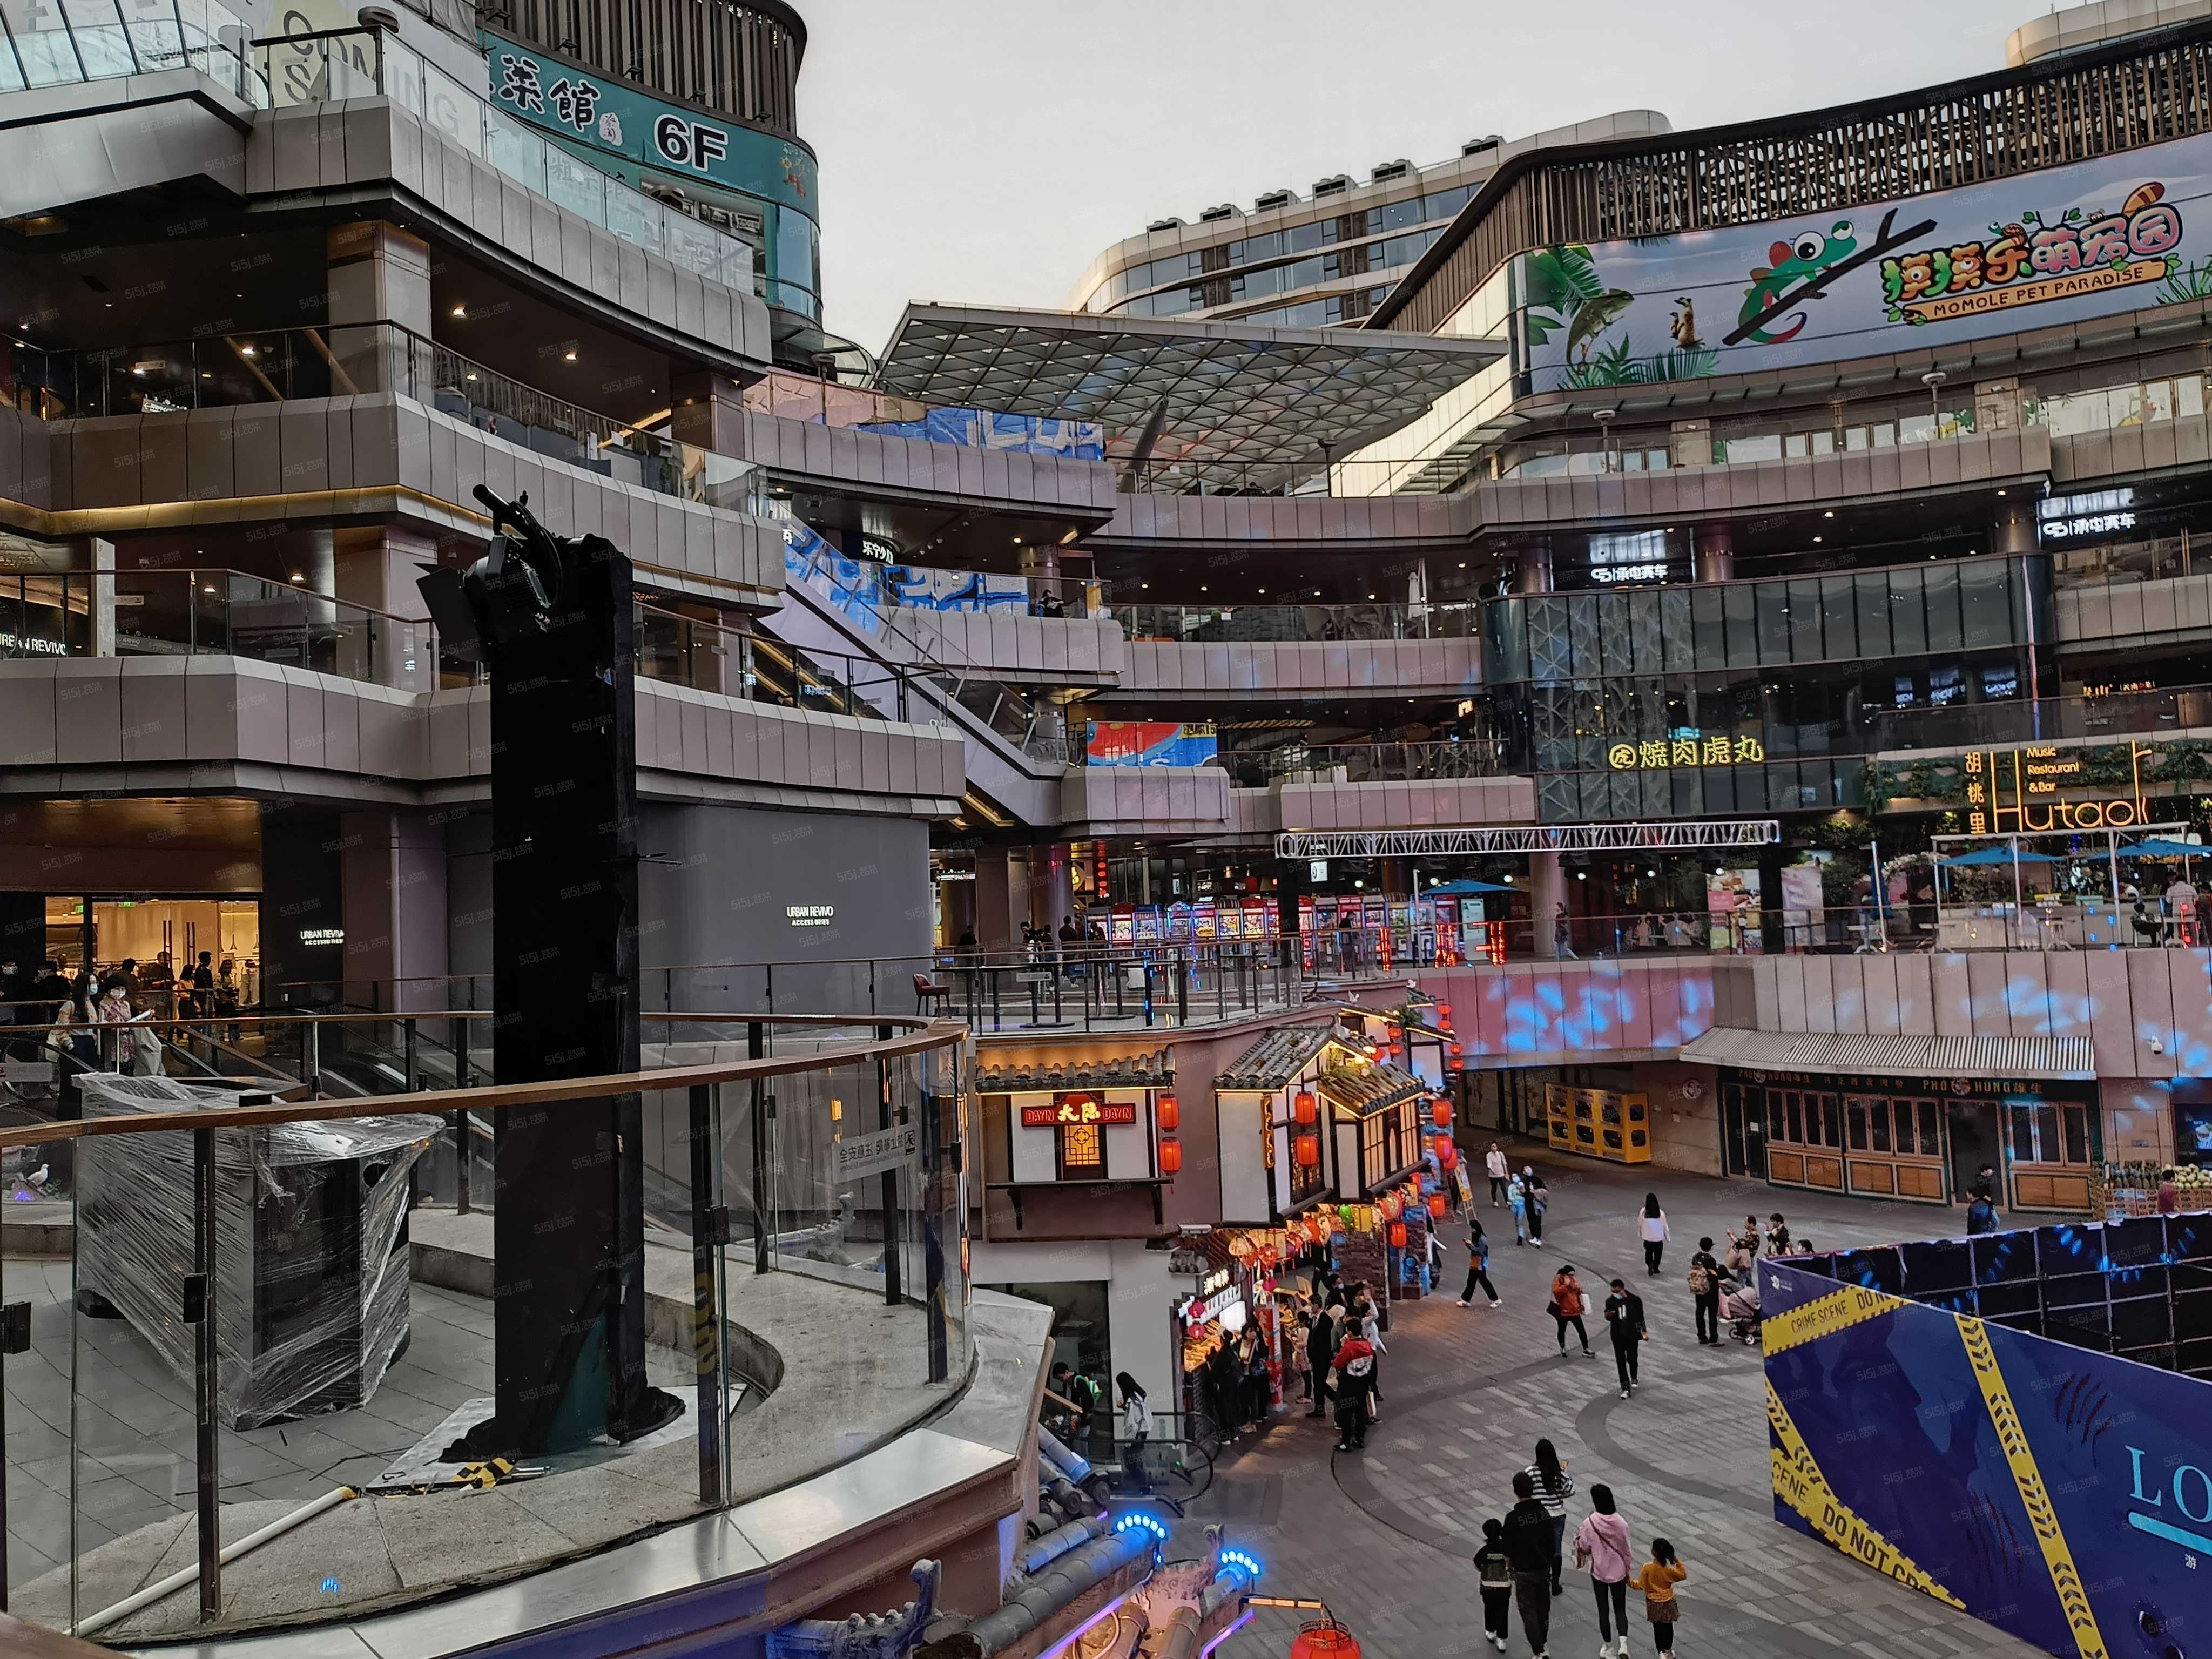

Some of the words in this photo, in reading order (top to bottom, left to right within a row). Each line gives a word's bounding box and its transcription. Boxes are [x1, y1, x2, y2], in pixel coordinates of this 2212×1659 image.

[654, 114, 728, 172] 6F
[1934, 292, 2009, 317] MOMOLE
[2017, 285, 2047, 301] PET
[2054, 267, 2143, 295] PARADISE
[2026, 746, 2056, 758] Music
[2027, 761, 2079, 775] Restaurant
[786, 906, 809, 917] URBAN
[300, 929, 322, 939] URBAN
[1790, 1311, 1818, 1334] CRIME
[1818, 1299, 1849, 1324] SCENE
[1856, 1290, 1873, 1310] DO
[1823, 1503, 1847, 1537] DO
[1850, 1526, 1890, 1572] NOT
